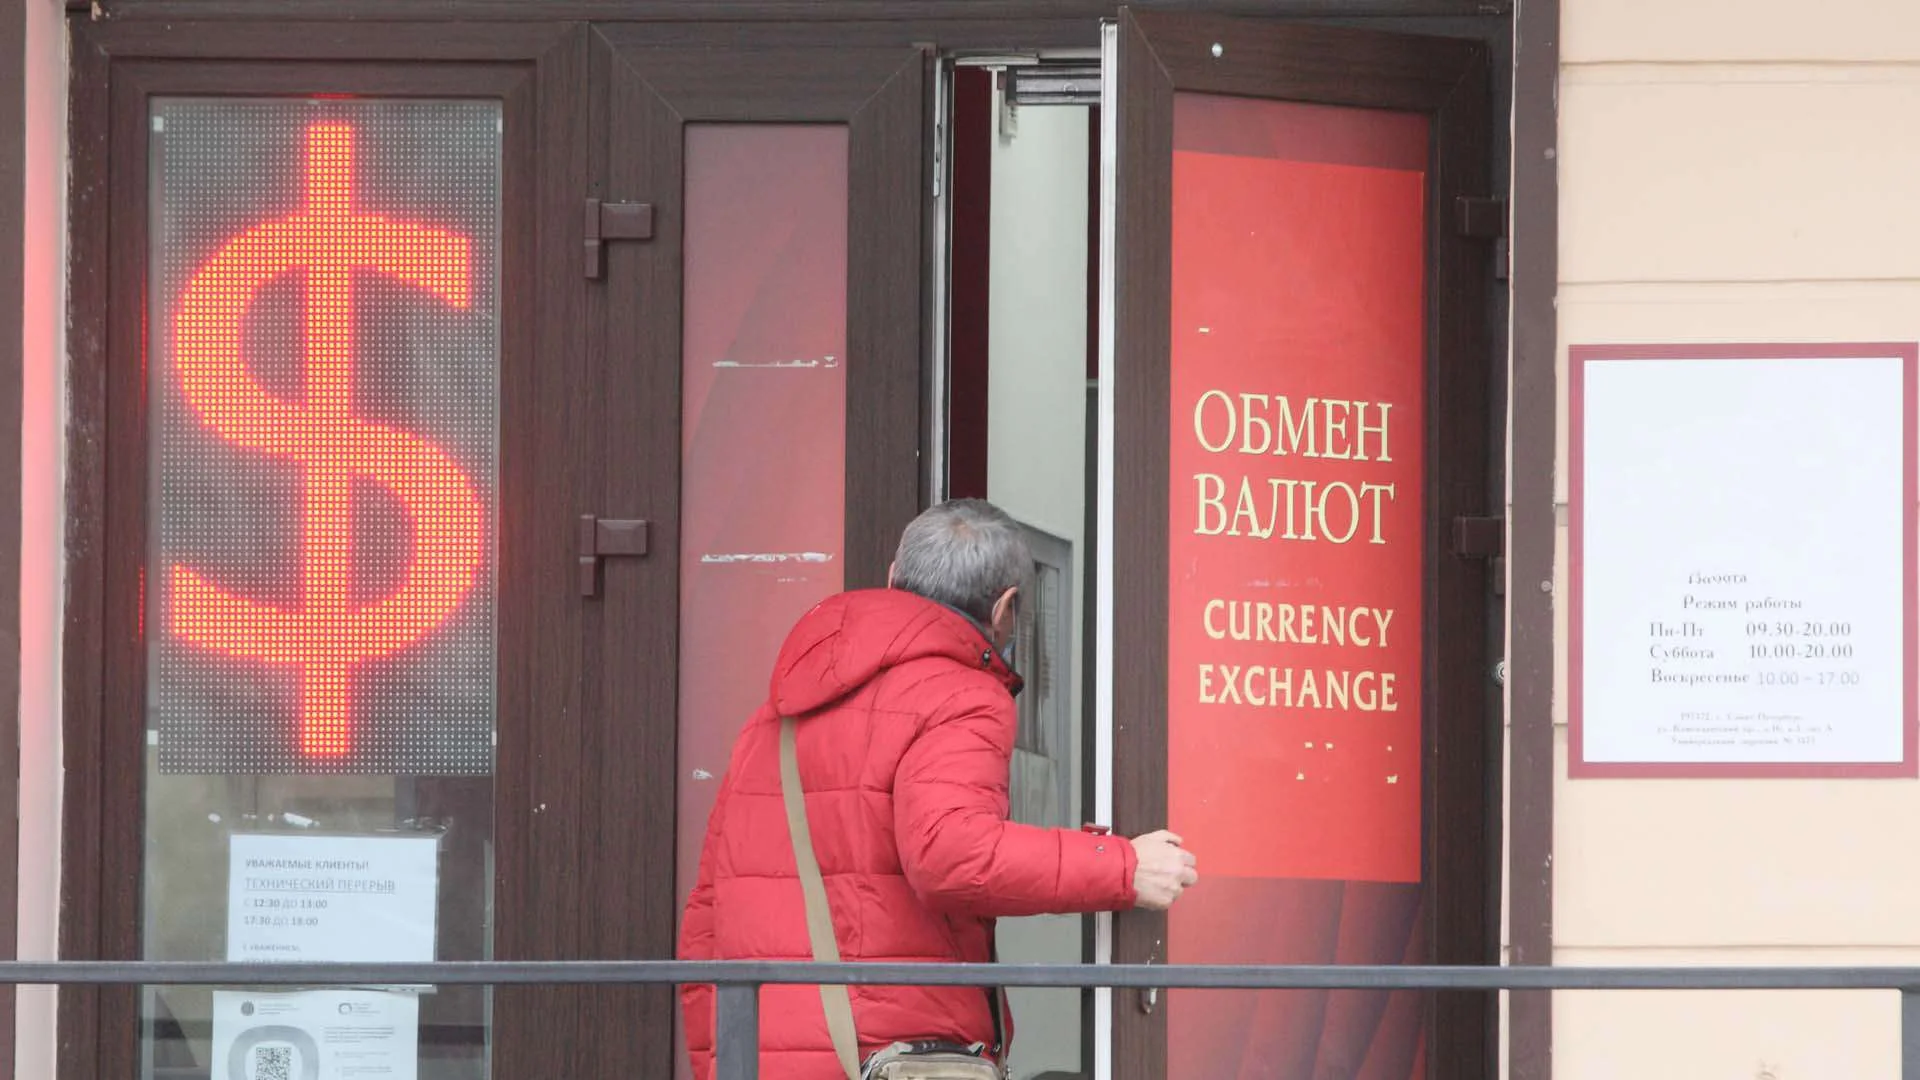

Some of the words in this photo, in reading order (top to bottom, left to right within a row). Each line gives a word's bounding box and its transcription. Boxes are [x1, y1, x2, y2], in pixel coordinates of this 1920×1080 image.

[1193, 389, 1393, 462] ОБМЕН
[1193, 473, 1395, 545] ВАЛЮТ
[1682, 594, 1738, 609] Режим
[1745, 595, 1803, 613] работы
[1203, 599, 1394, 648] CURRENCY
[1745, 621, 1852, 637] 09.30-20.00
[1649, 643, 1715, 662] Суббота
[1750, 643, 1853, 659] 10.00-20.00
[1651, 668, 1750, 686] Воскресенье
[1199, 664, 1398, 712] EXCHANGE
[245, 859, 313, 870] УВАЖАЕМЫЕ
[244, 877, 335, 891] ТЕХНИЧЕСКИЙ
[338, 879, 396, 893] ПЕРЕРЫВ
